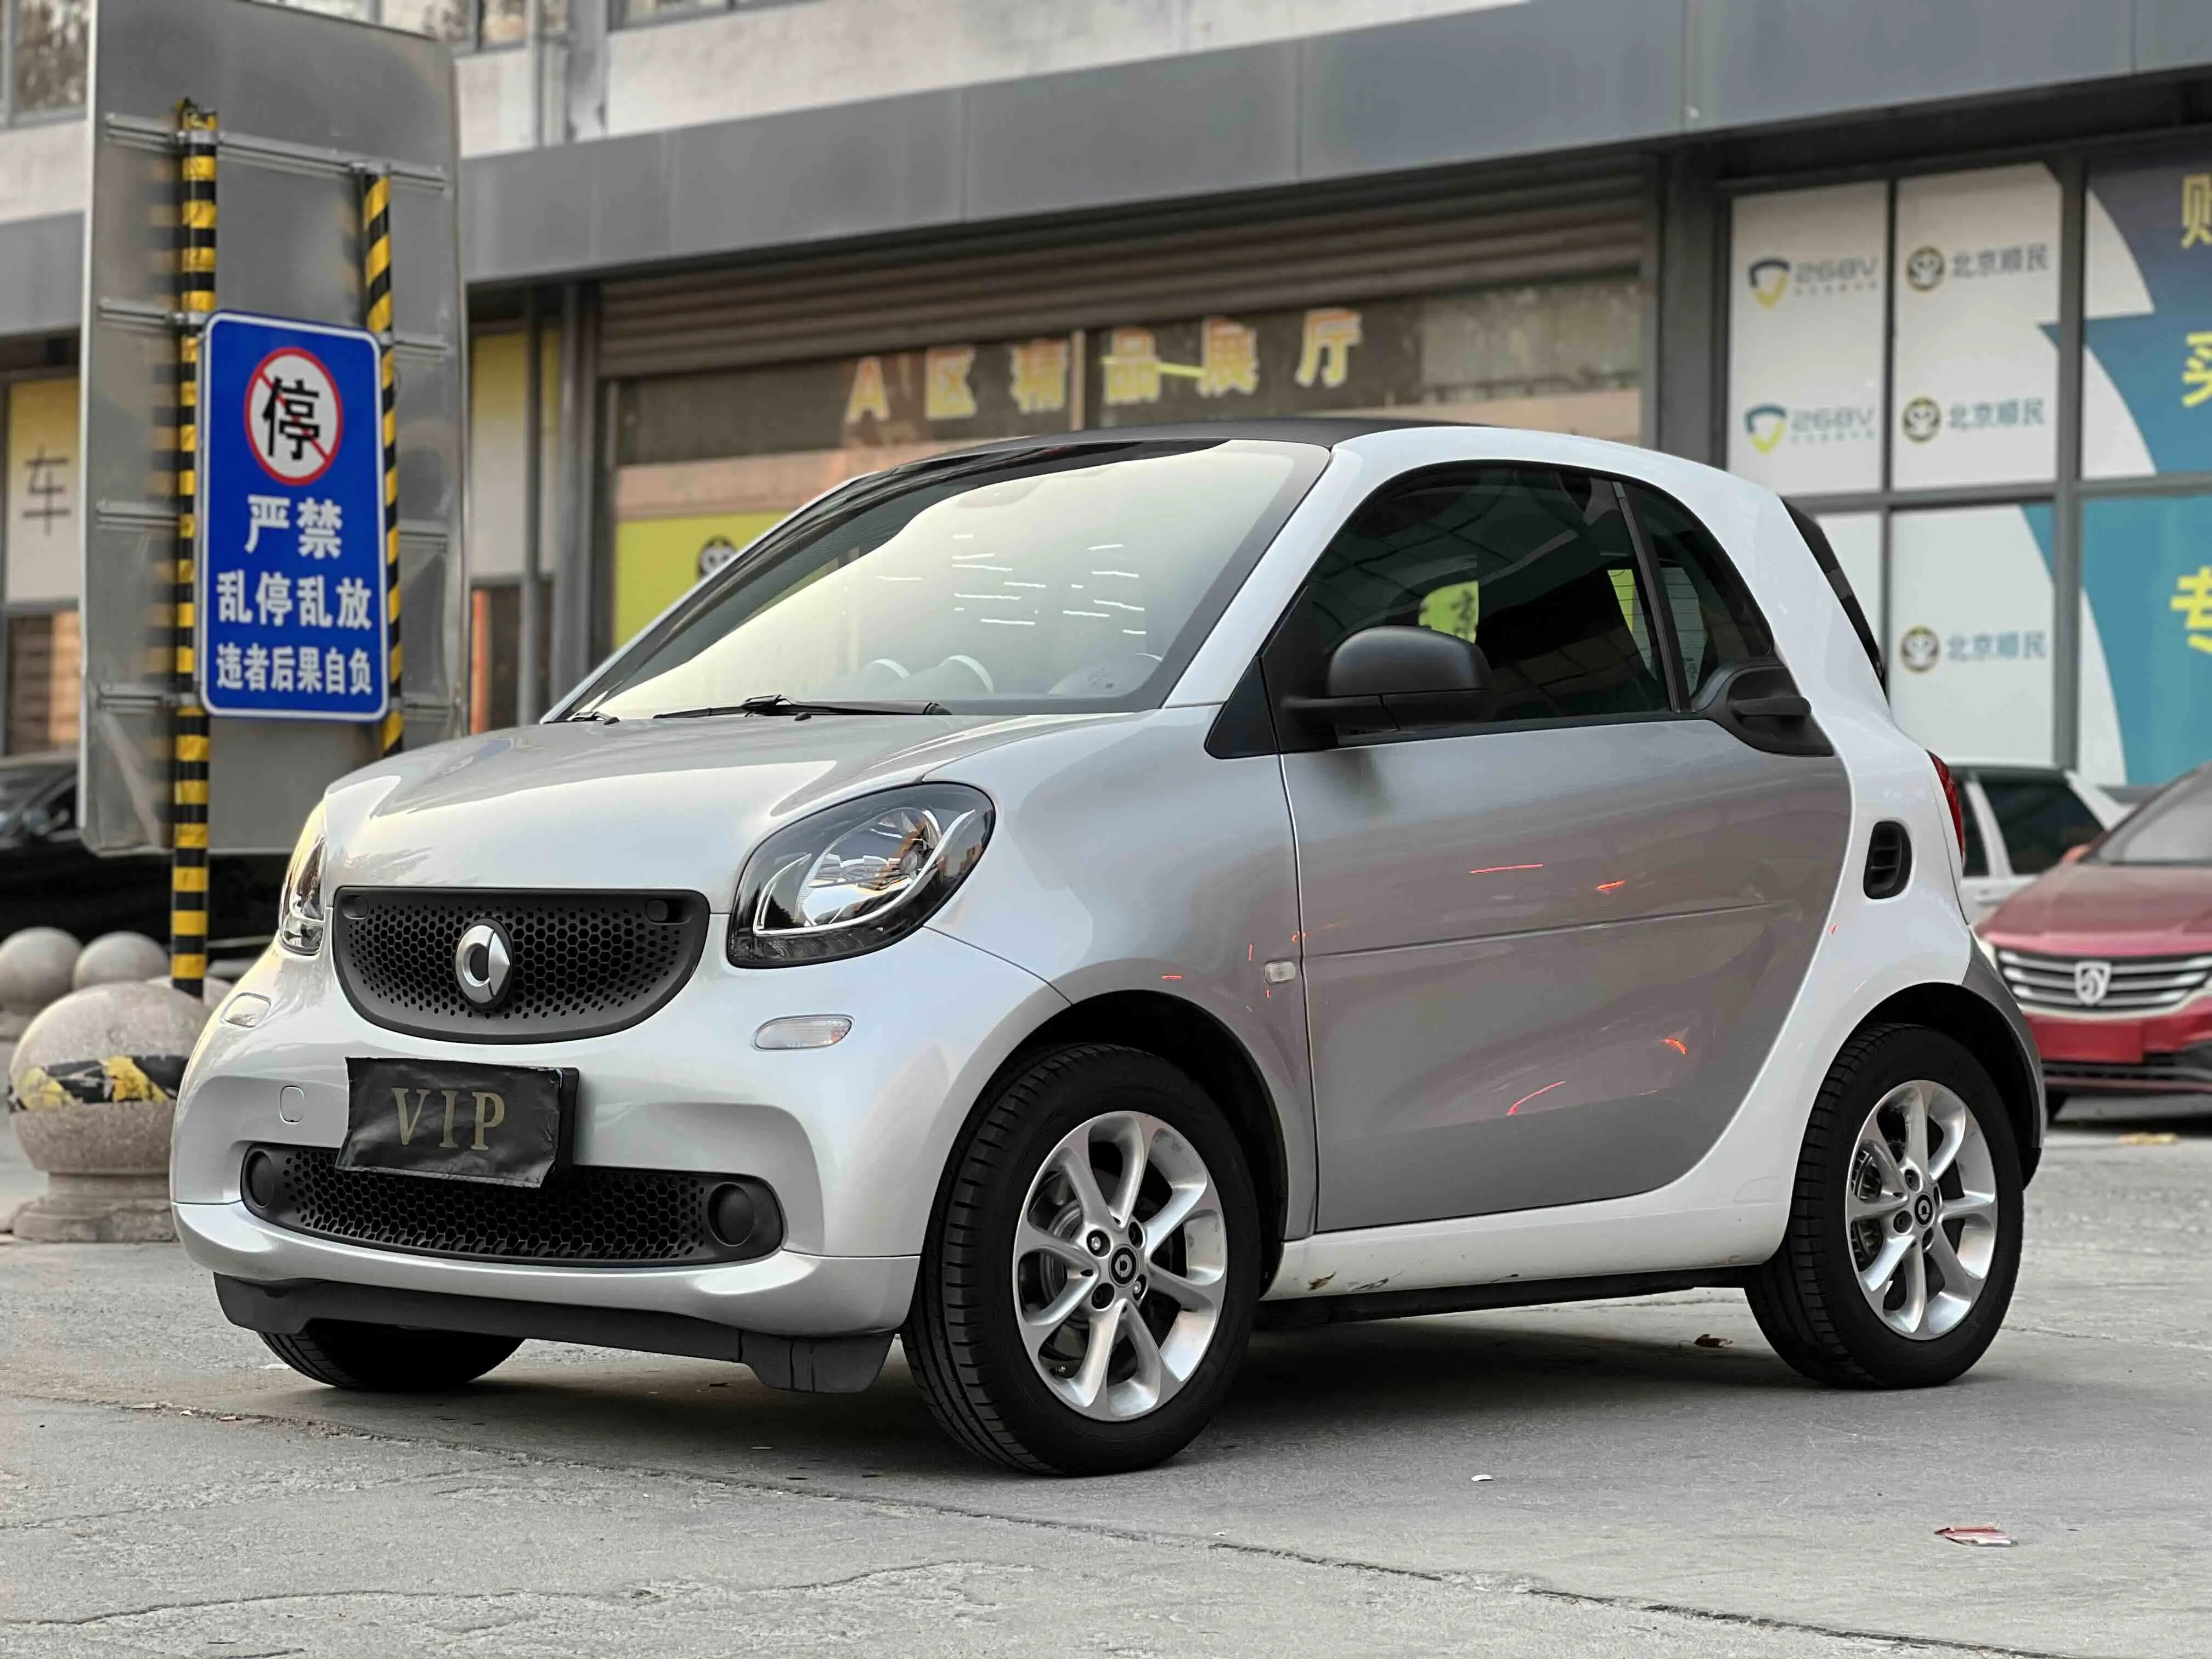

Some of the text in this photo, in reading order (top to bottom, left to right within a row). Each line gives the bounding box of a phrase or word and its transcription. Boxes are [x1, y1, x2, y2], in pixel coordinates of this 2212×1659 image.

[262, 375, 320, 461] 停
[22, 443, 72, 537] 车
[244, 494, 343, 559] 严禁
[216, 568, 373, 630] 乱停乱放
[216, 641, 374, 696] 违者后果自负
[391, 1087, 505, 1150] VIP
